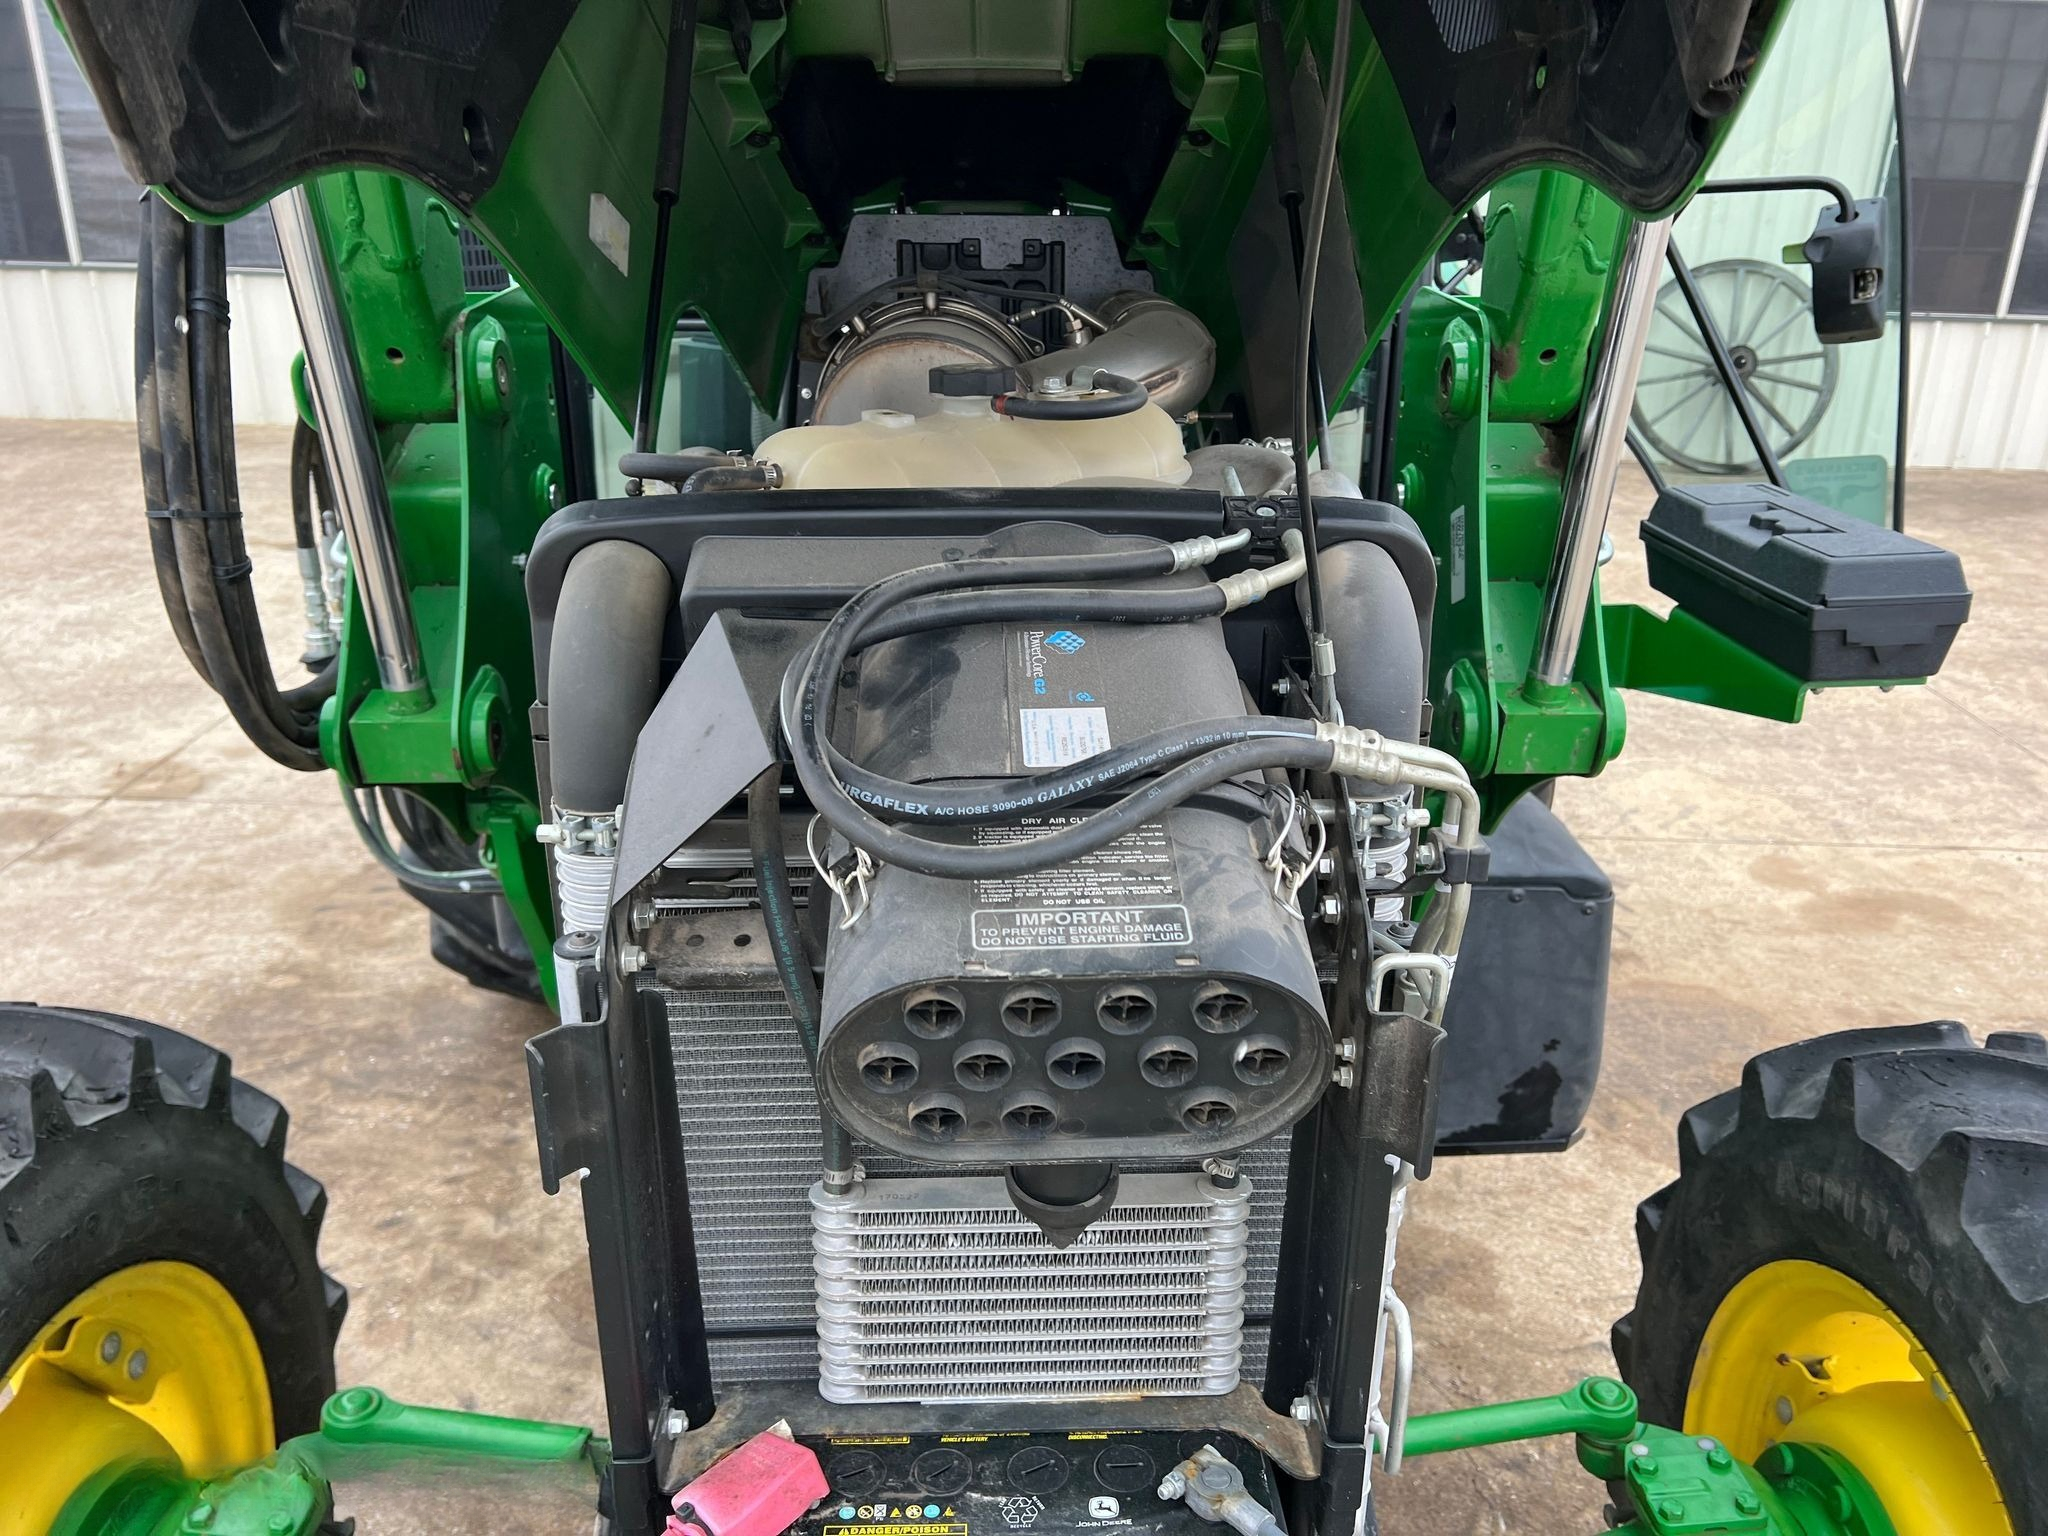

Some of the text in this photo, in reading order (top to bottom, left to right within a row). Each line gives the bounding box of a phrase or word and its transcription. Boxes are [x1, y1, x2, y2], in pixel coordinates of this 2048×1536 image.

[1030, 630, 1047, 695] PowerCore G2
[840, 781, 929, 816] URGAFLEX
[934, 806, 955, 816] A/C
[958, 805, 990, 815] HOSE
[992, 796, 1034, 812] 3090-08
[1037, 776, 1096, 803] GALAXY
[1098, 770, 1116, 782] SAE
[1116, 760, 1139, 778] J2064
[1139, 753, 1158, 765] Type
[1158, 749, 1164, 757] C
[1164, 744, 1184, 755] Class
[1195, 735, 1214, 746] 13/32
[1016, 910, 1144, 926] IMPORTANT
[774, 915, 784, 937] Hose
[980, 923, 1182, 937] TO PREVENT ENGINE DAMAGE
[982, 932, 1184, 946] DO NOT USE STARTING FLUID
[1102, 1518, 1132, 1526] DEERE
[850, 1527, 948, 1535] DANGER/POISON
